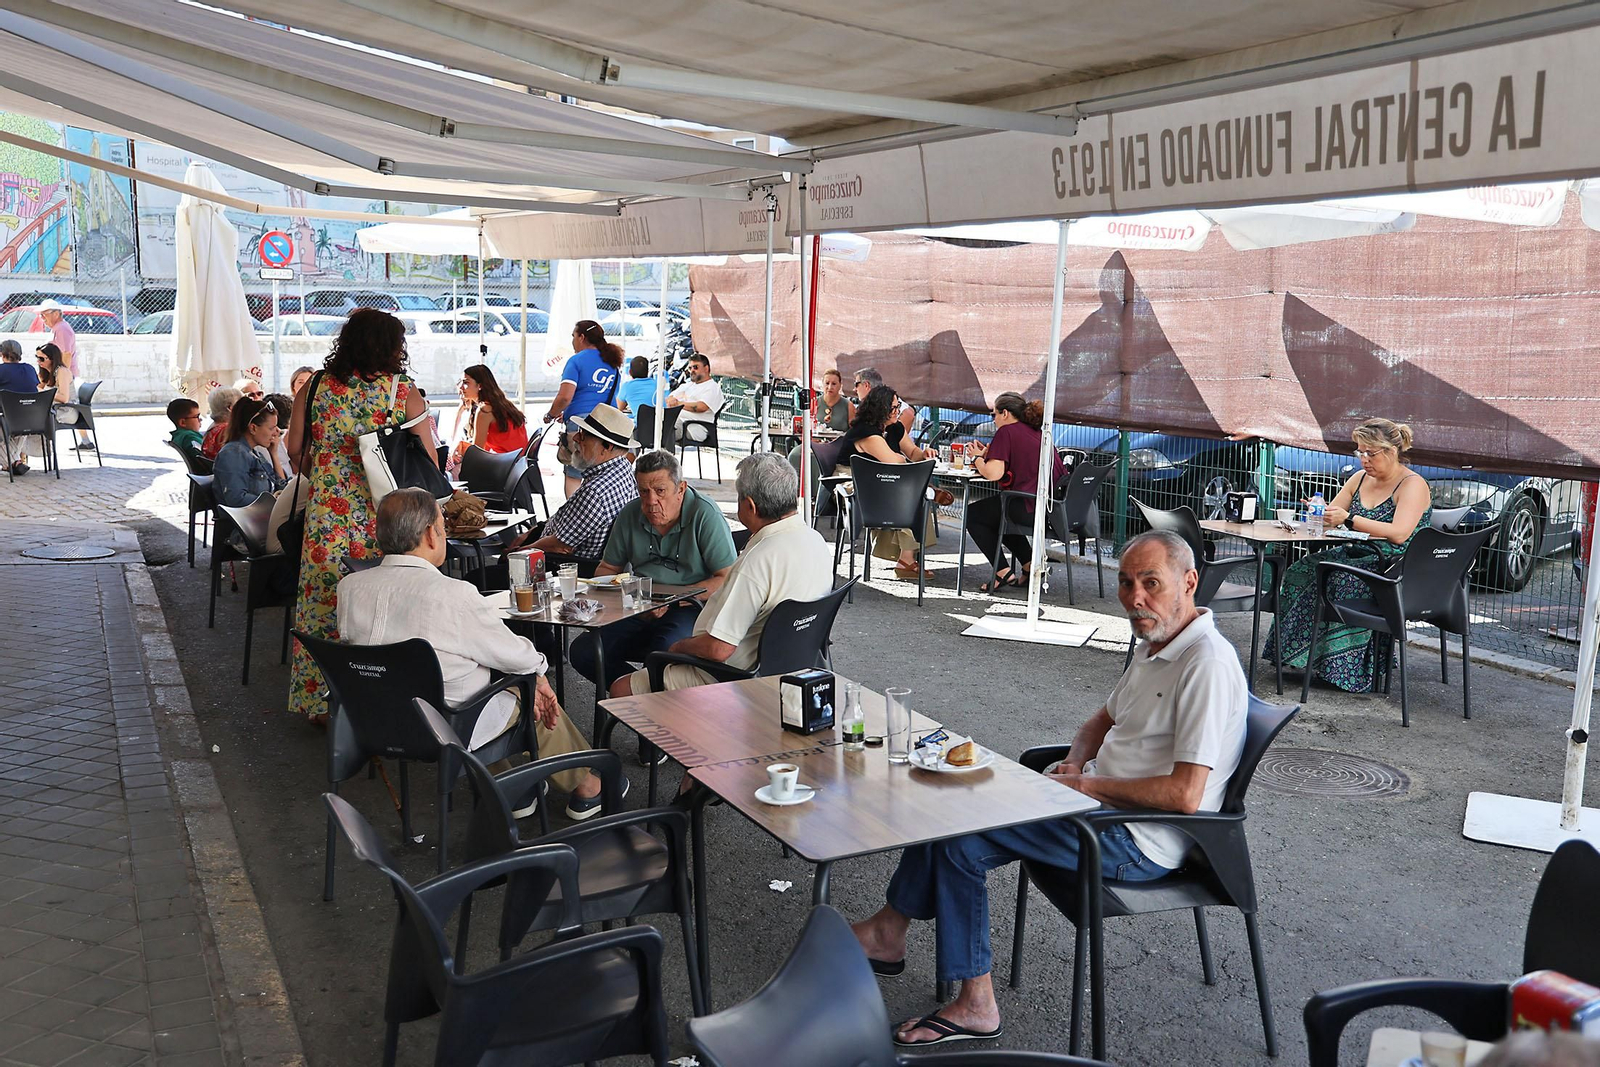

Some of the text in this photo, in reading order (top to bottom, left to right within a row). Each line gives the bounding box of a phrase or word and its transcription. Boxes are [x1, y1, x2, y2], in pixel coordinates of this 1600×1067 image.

[146, 156, 182, 167] Hospital
[592, 368, 615, 393] Gf
[349, 661, 387, 672] Cruzcampo
